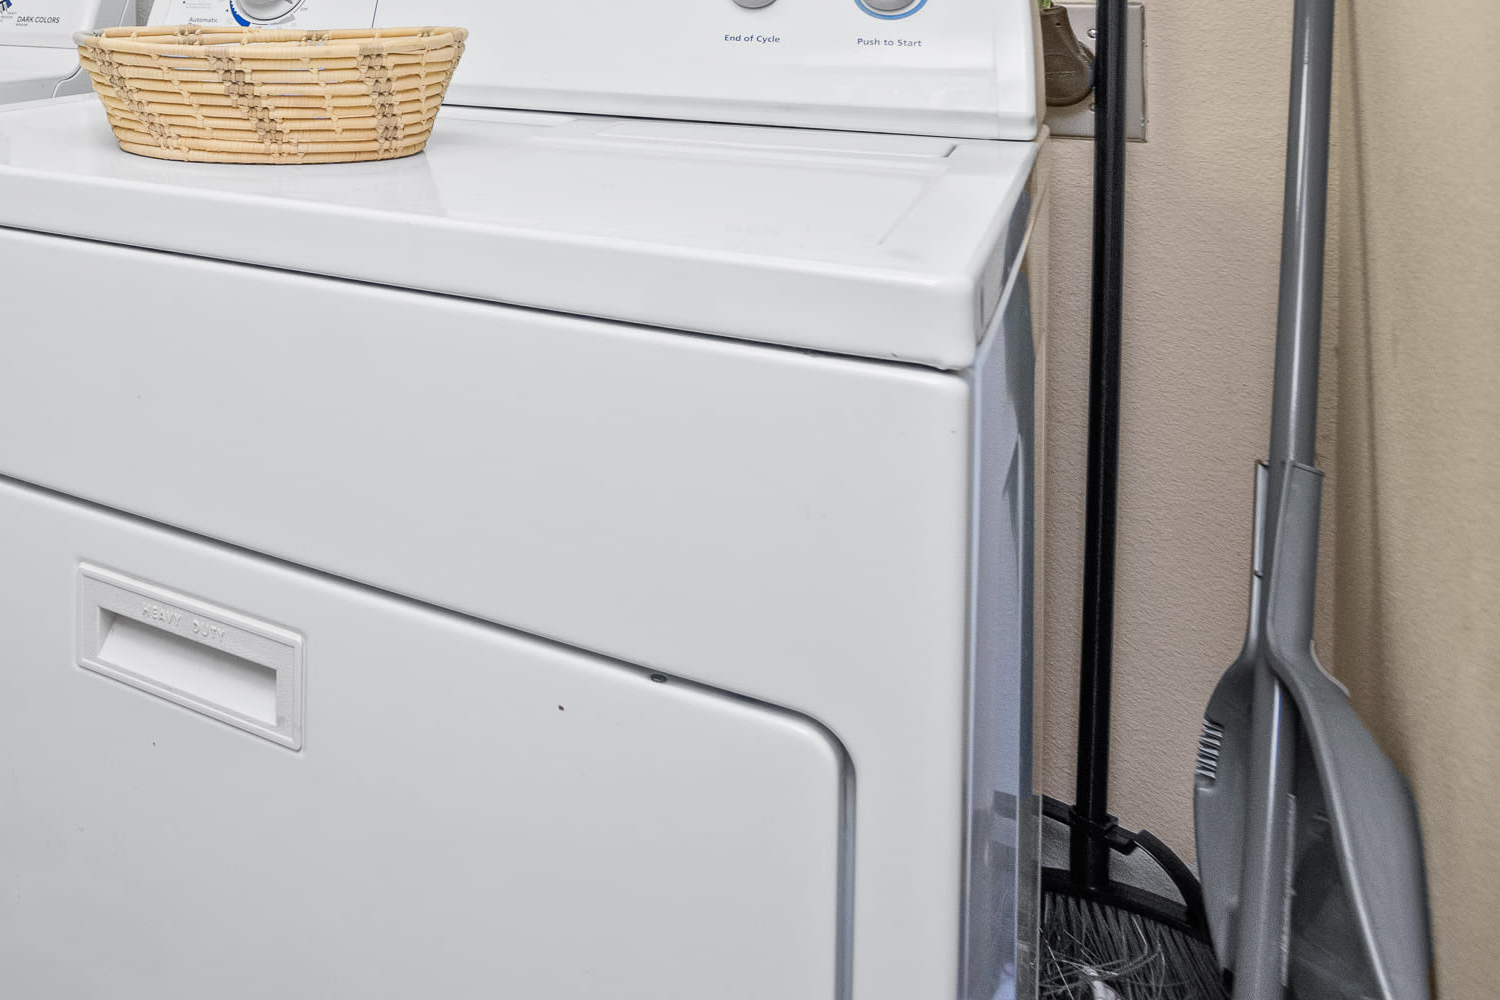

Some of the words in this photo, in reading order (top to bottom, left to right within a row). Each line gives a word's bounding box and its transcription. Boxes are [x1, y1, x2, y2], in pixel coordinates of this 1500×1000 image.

[35, 16, 60, 24] COLORS
[724, 34, 741, 42] End
[743, 34, 754, 42] of
[756, 35, 781, 44] Cycle
[857, 37, 880, 46] Push
[897, 39, 922, 47] Start
[141, 602, 182, 627] HEAVY
[192, 618, 226, 642] DUTY
